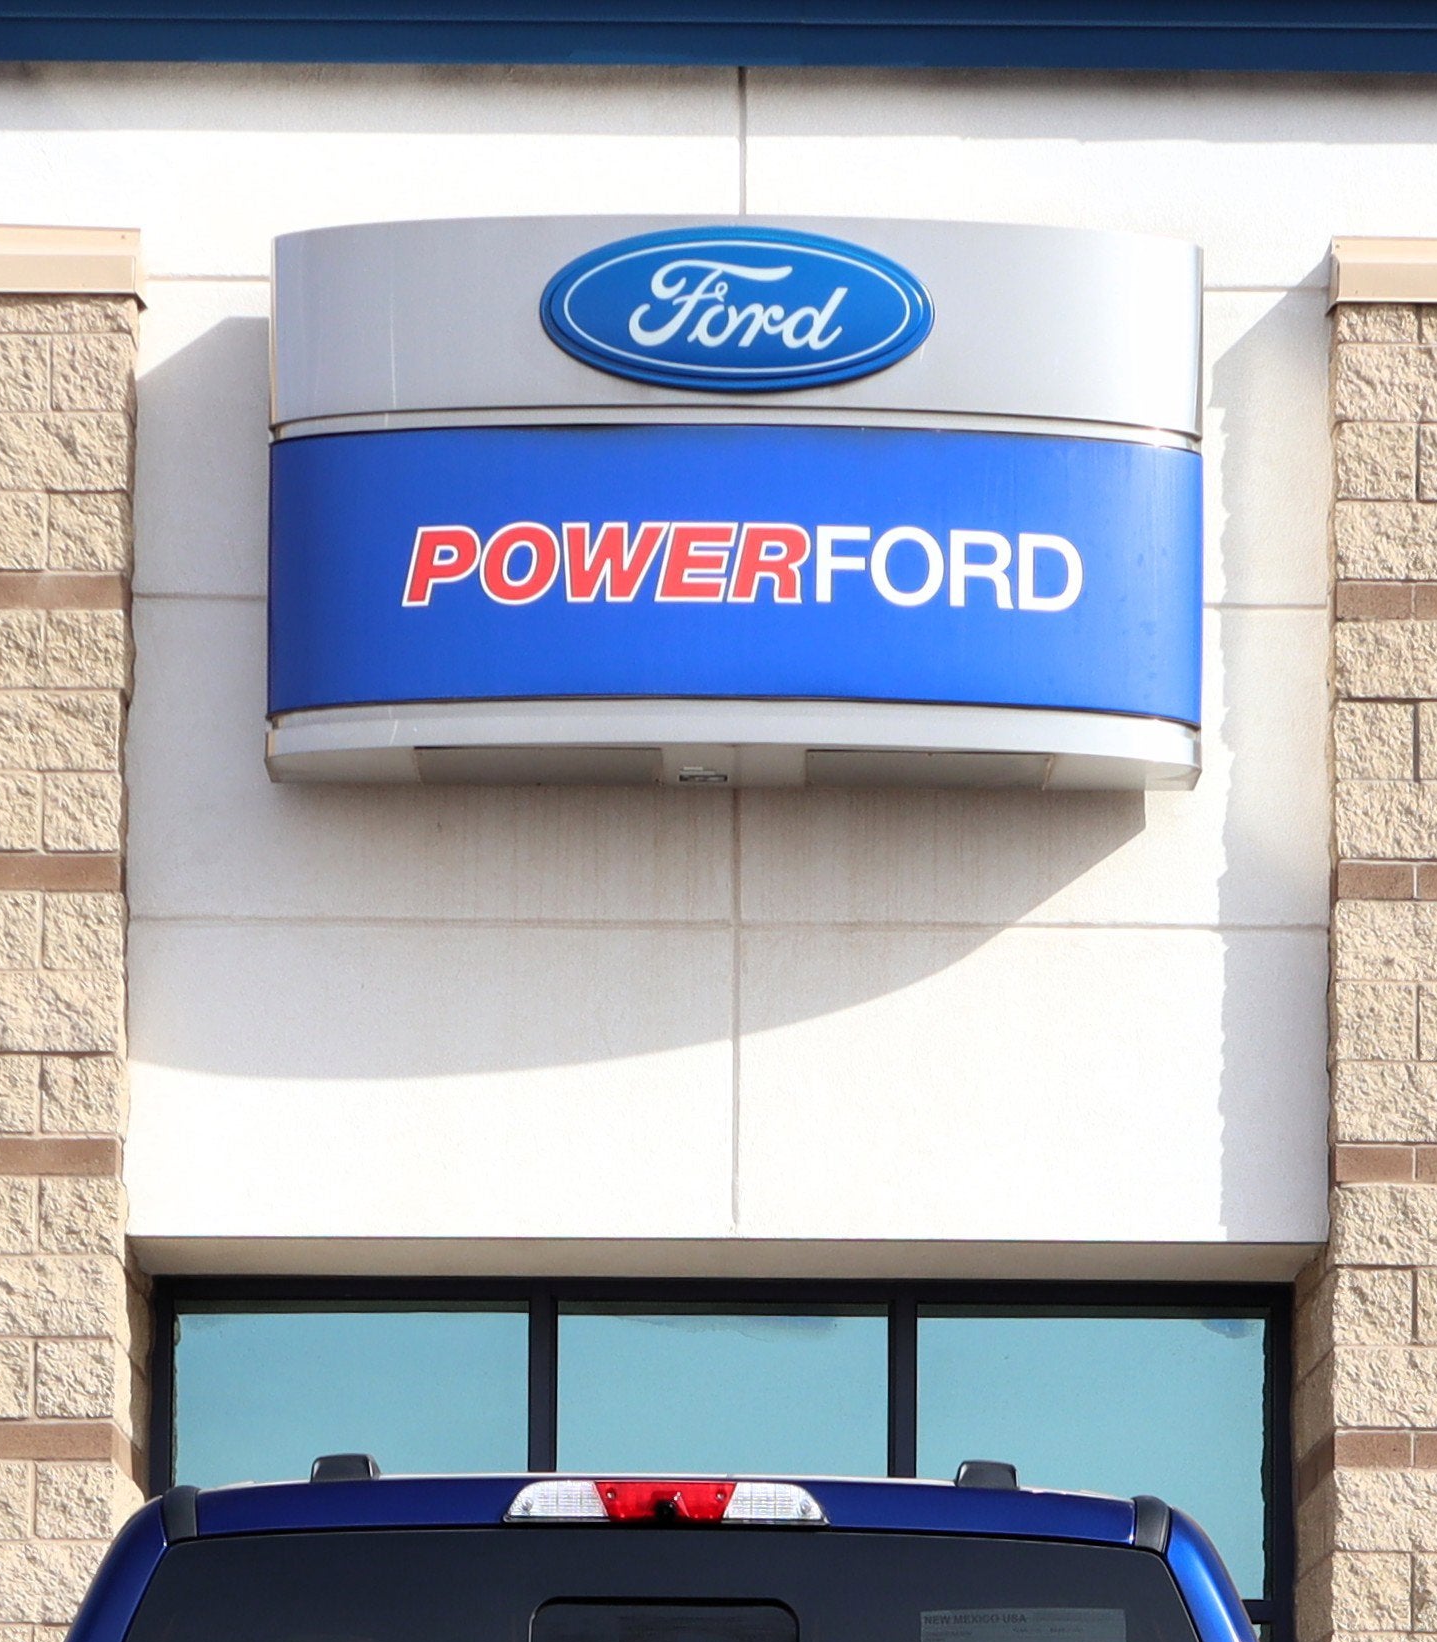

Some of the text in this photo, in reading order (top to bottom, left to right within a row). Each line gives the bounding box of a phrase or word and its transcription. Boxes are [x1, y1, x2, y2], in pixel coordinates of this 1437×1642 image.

[628, 259, 849, 351] Ford
[924, 1614, 951, 1625] NEW
[953, 1613, 1000, 1625] MEXICO
[1002, 1613, 1028, 1624] USA
